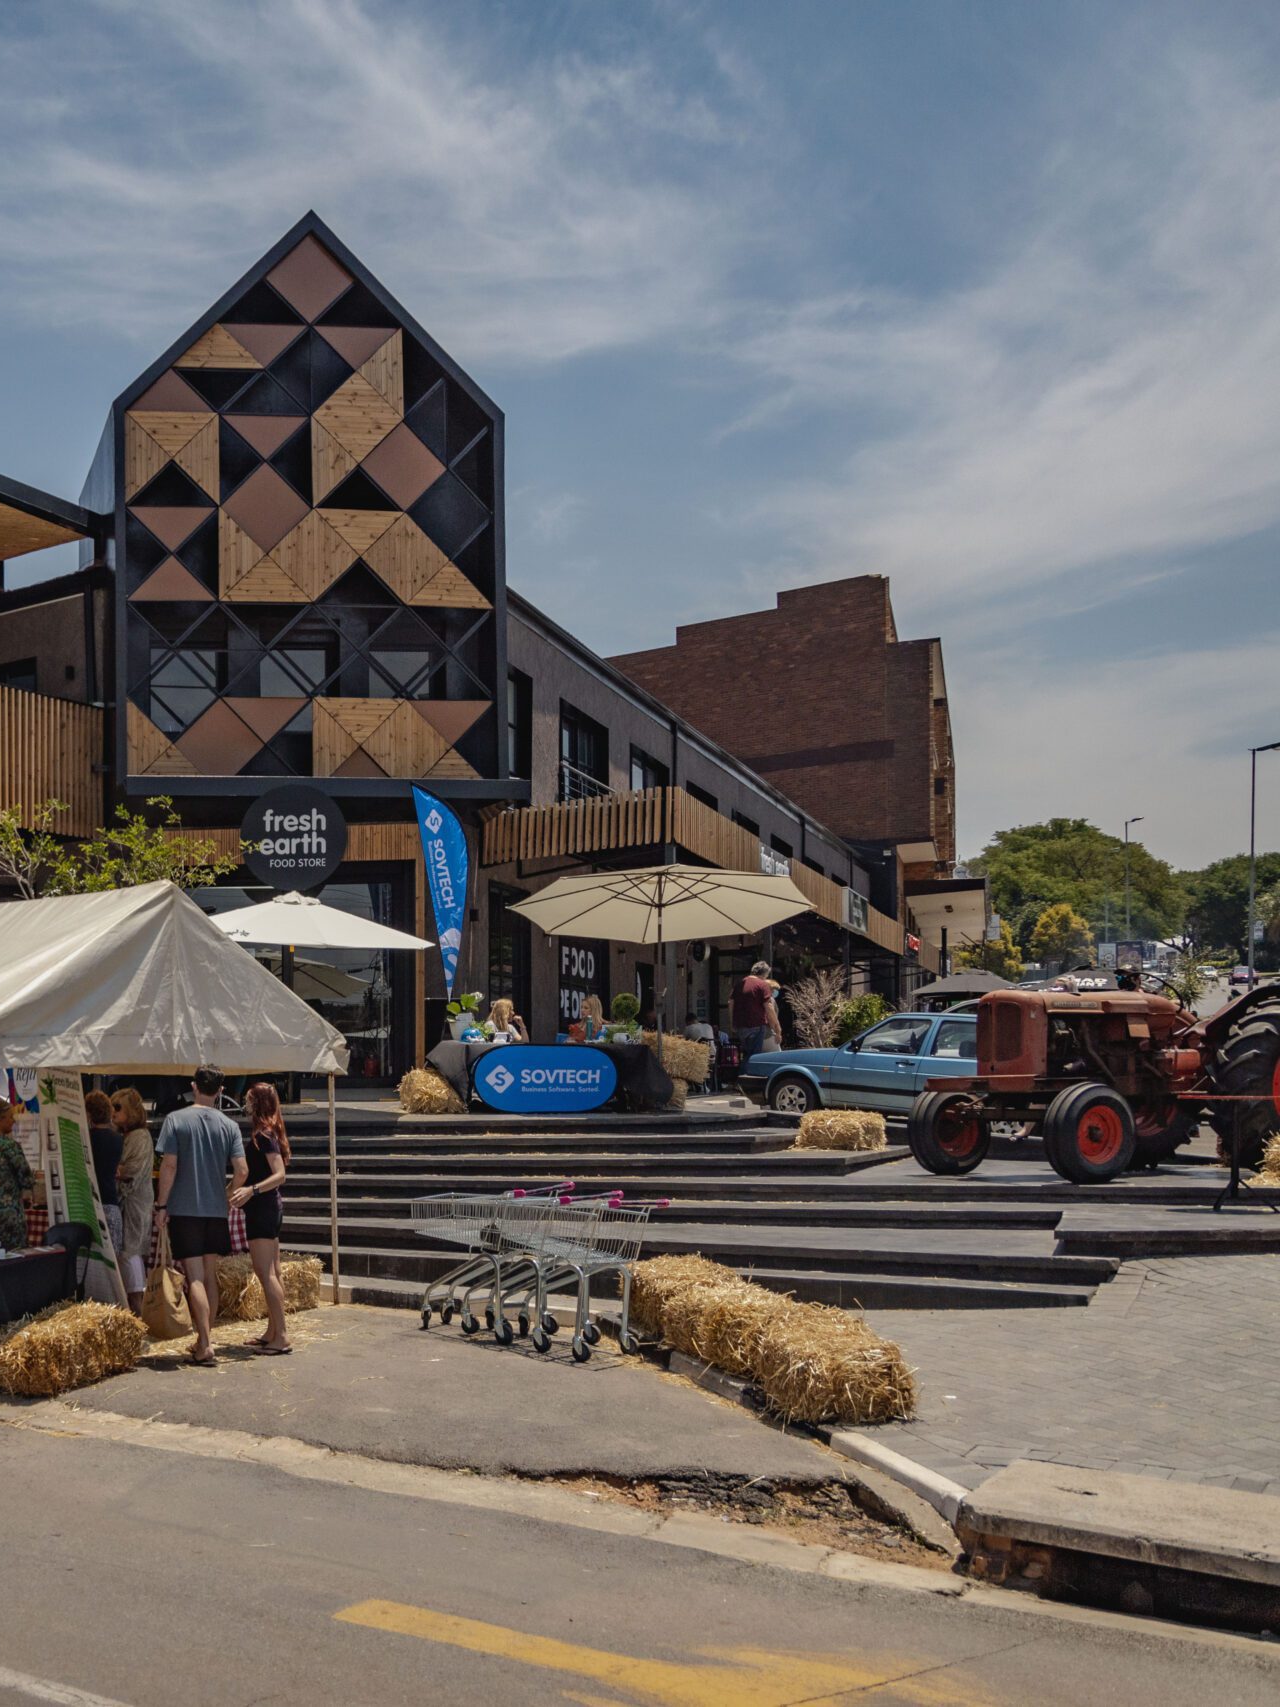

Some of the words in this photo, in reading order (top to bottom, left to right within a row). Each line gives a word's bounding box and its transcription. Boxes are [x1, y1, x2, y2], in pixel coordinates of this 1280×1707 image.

[262, 807, 327, 832] fresh
[259, 831, 327, 855] earth
[269, 858, 296, 869] FOOD
[298, 857, 327, 868] STORE
[434, 839, 455, 908] SOVTECH
[520, 1068, 601, 1085] SOVTECH
[521, 1085, 547, 1093] Business
[548, 1085, 576, 1093] Software.
[578, 1085, 600, 1093] Sorted.
